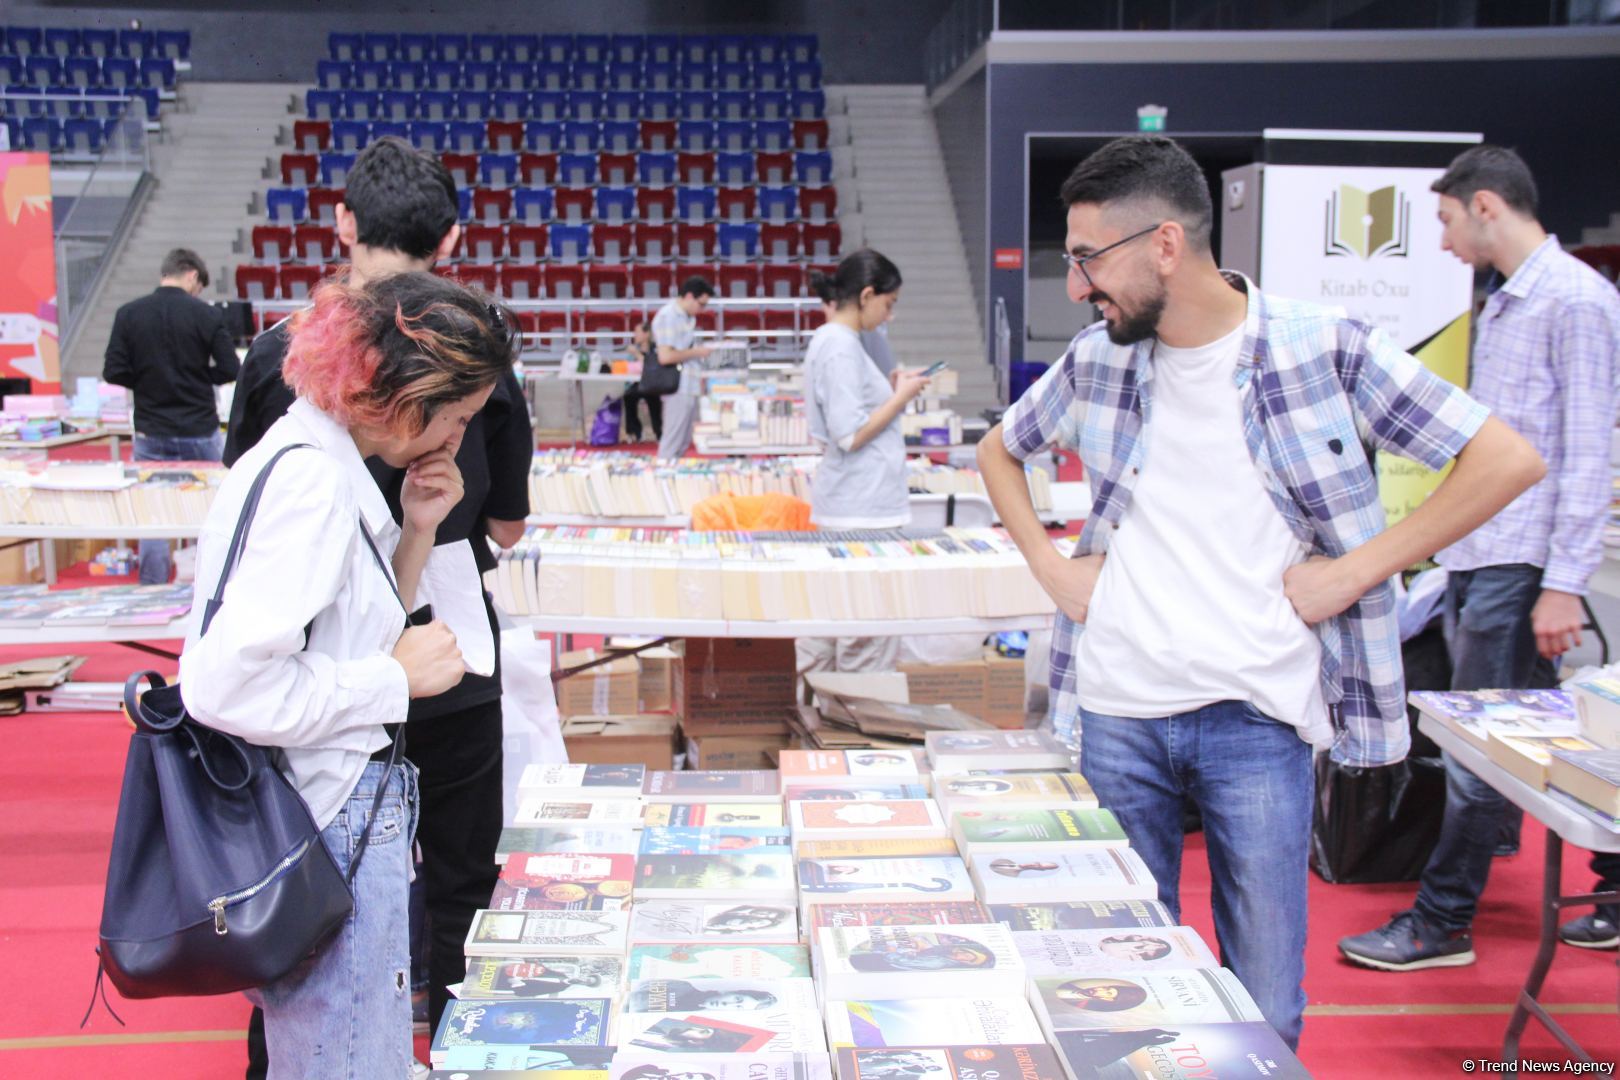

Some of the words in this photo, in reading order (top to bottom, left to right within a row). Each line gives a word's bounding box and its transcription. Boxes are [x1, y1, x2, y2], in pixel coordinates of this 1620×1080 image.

[1319, 278, 1368, 297] Kitab
[1372, 280, 1411, 297] Oxu
[1169, 1043, 1218, 1080] TOY
